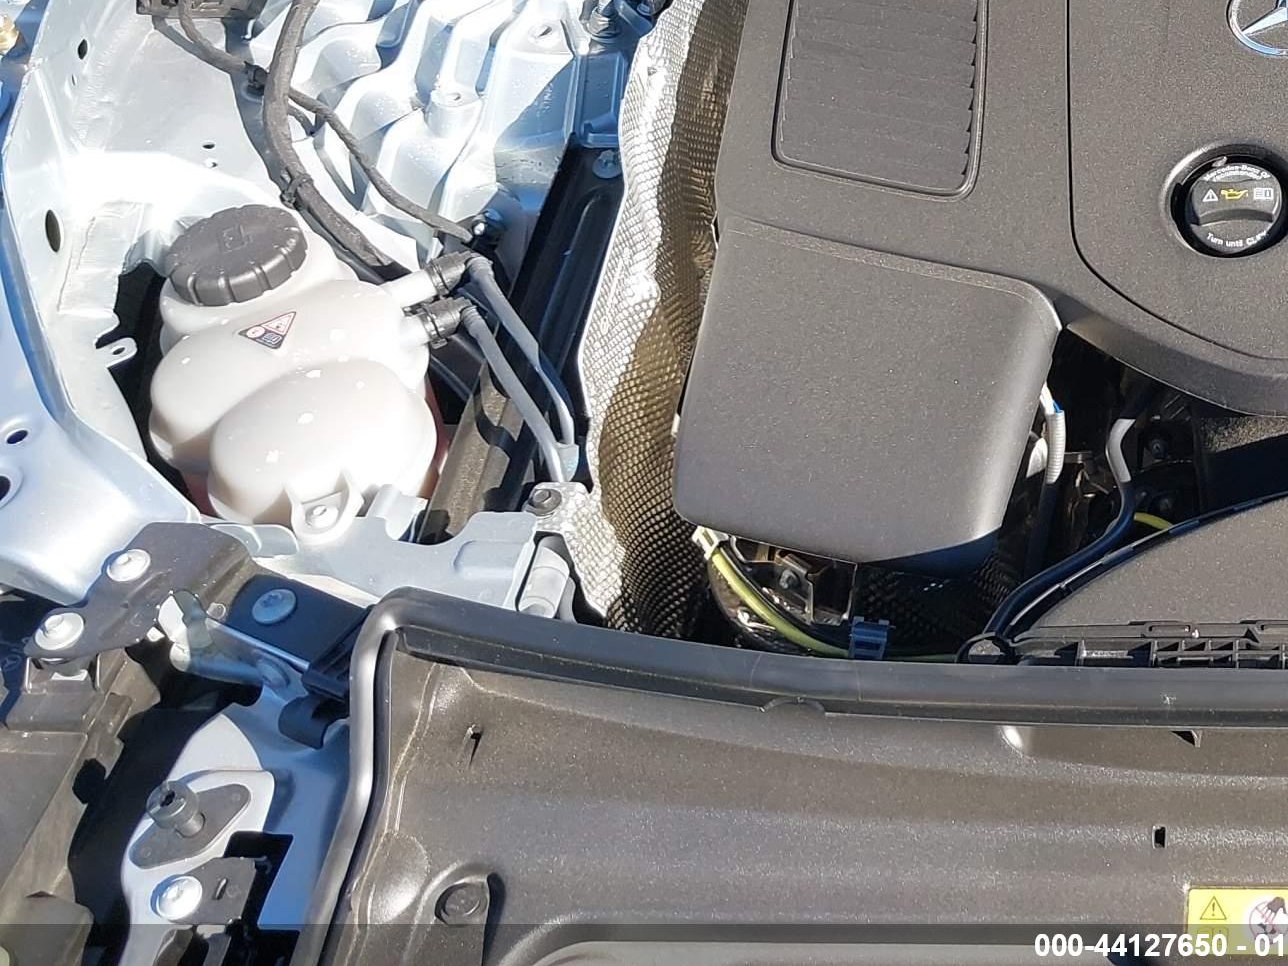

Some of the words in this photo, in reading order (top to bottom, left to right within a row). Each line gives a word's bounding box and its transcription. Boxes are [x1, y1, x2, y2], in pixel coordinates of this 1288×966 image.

[1203, 164, 1261, 181] Mercedes-Benz
[1206, 232, 1224, 245] Turn
[1225, 238, 1244, 247] until
